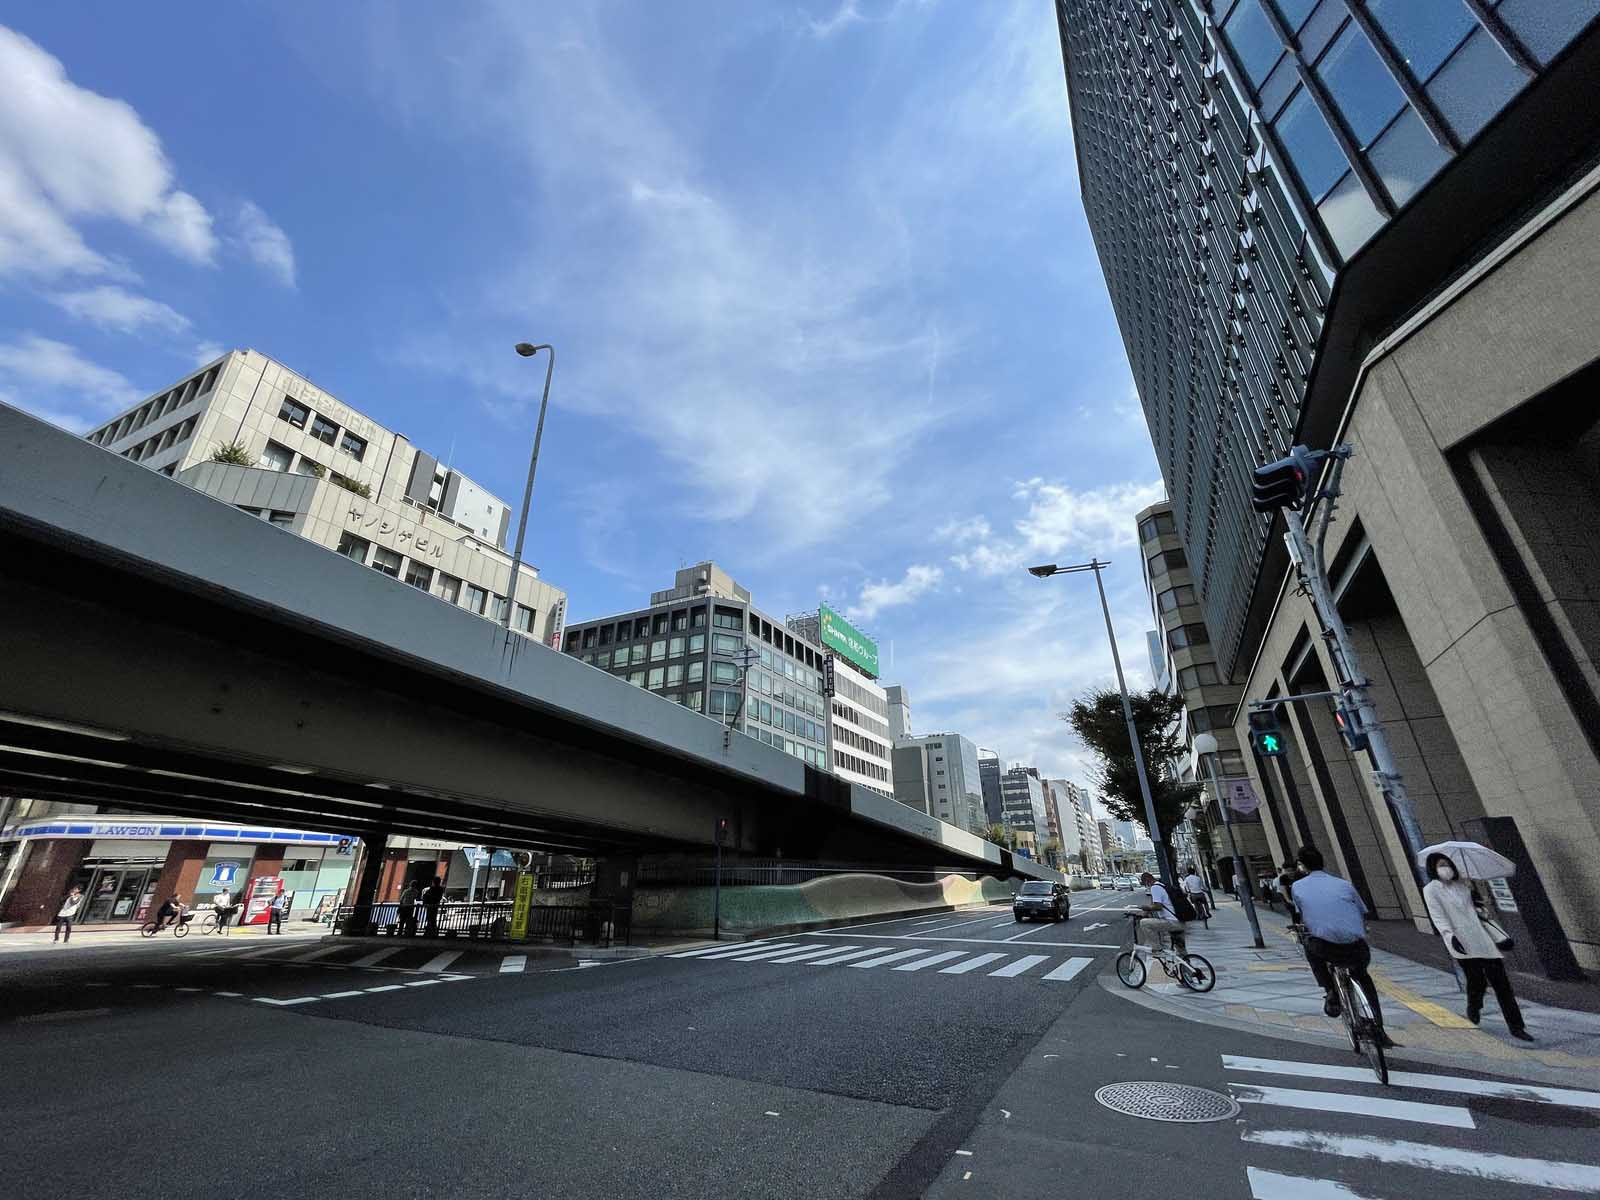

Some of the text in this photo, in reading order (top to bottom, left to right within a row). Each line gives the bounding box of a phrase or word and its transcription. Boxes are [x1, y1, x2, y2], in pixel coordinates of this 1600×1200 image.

[348, 508, 444, 558] ヤノシゲビル
[96, 826, 157, 836] LAWSON
